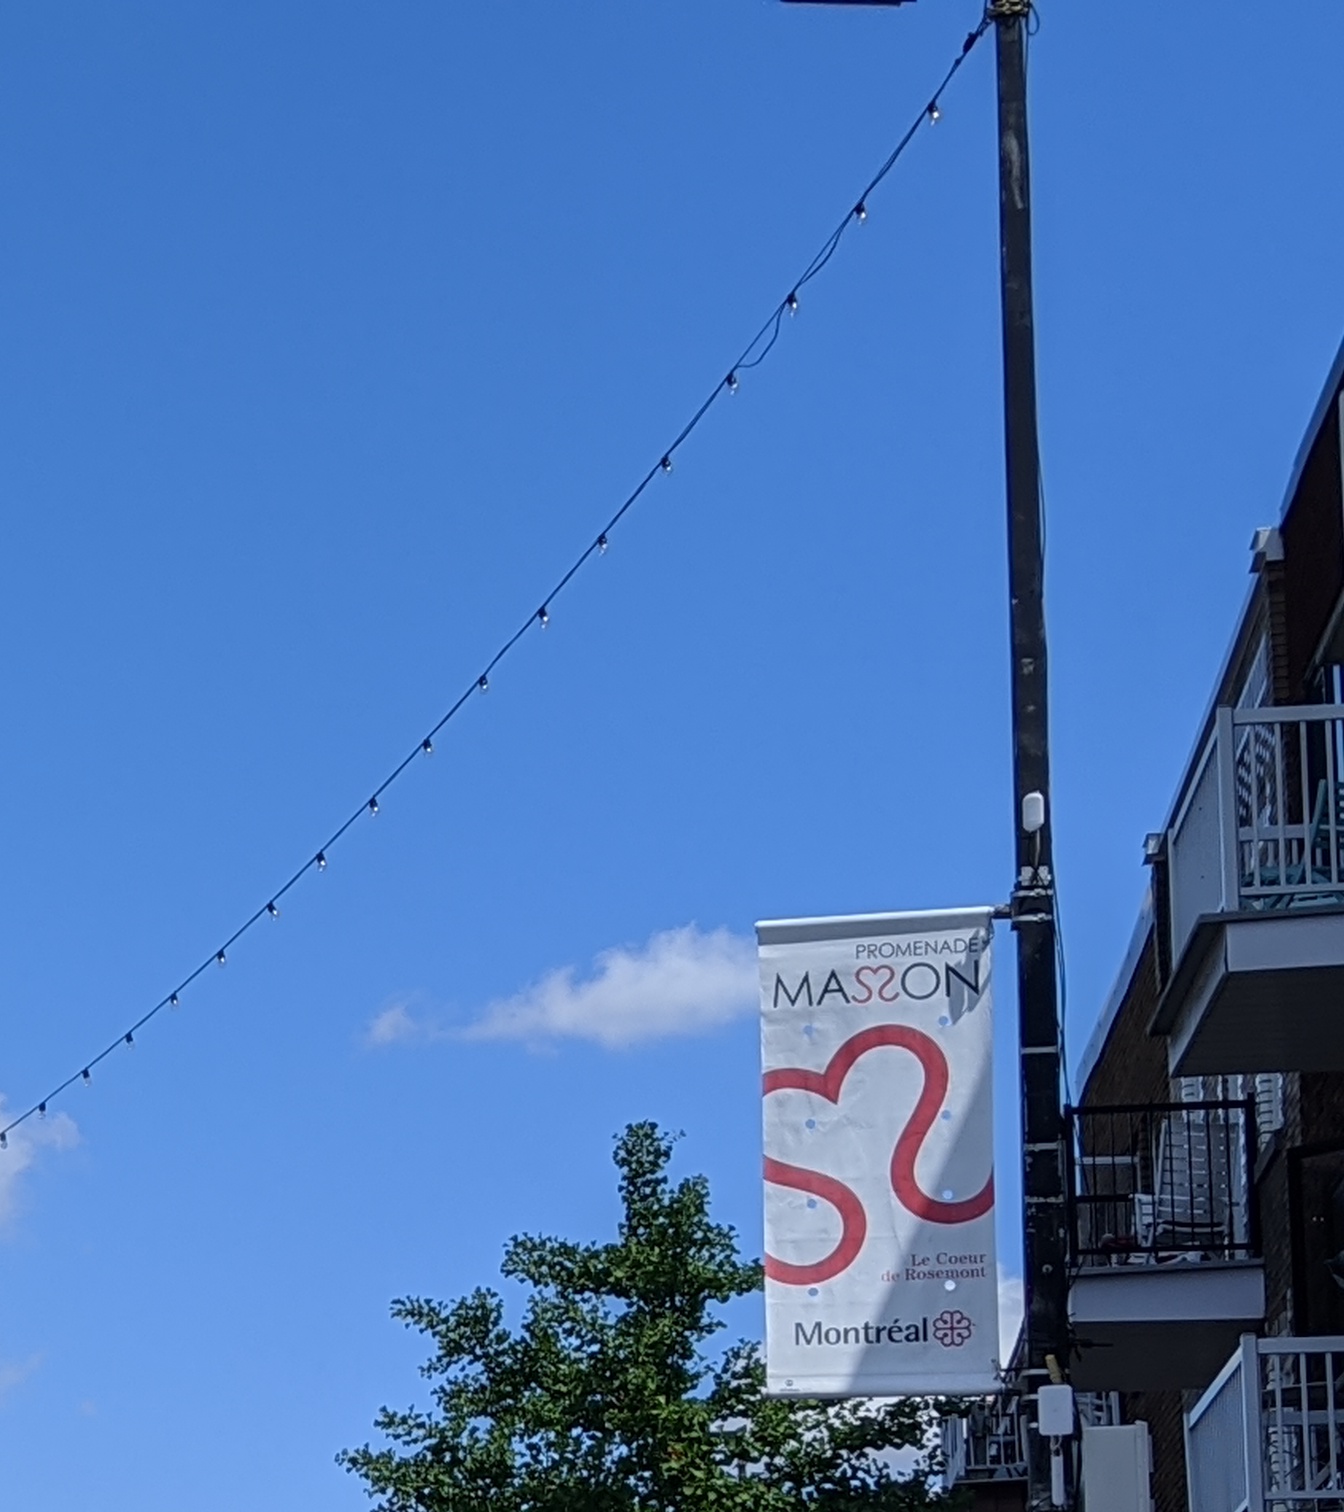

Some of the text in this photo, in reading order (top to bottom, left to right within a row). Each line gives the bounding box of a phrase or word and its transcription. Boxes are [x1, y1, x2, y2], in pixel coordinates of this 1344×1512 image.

[855, 938, 980, 960] PROMENADE
[772, 960, 982, 1009] MASSON
[911, 1252, 987, 1267] Le Coeur
[881, 1266, 987, 1282] de Rosemont
[794, 1317, 928, 1348] Montréal
